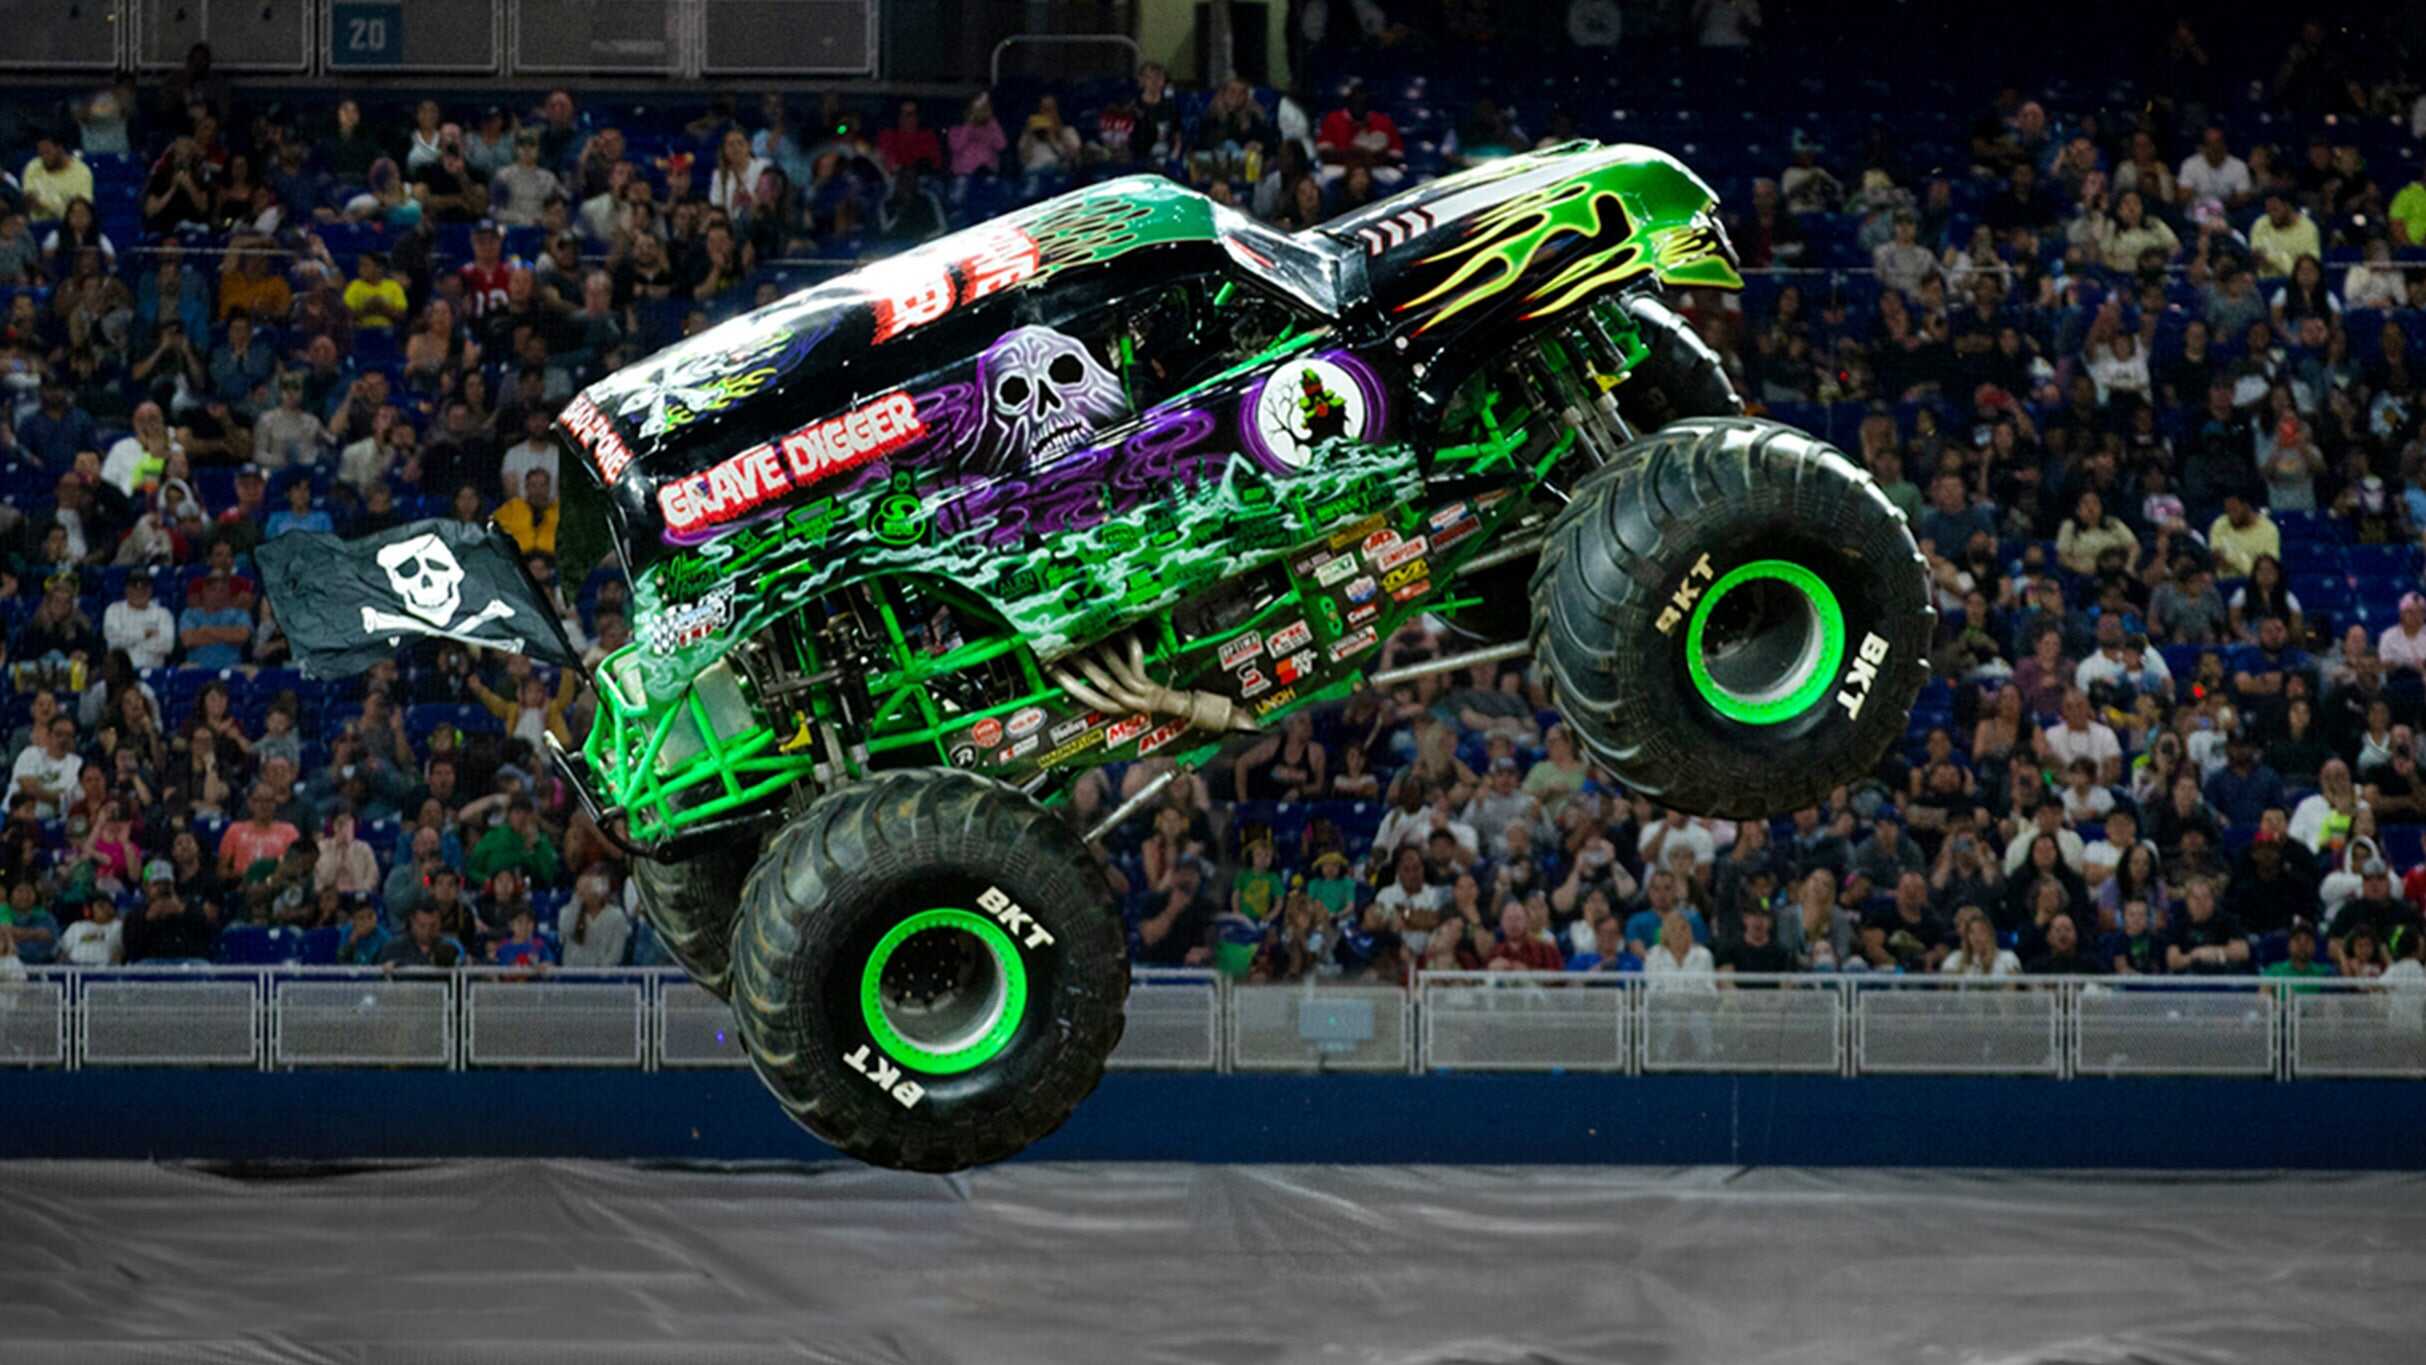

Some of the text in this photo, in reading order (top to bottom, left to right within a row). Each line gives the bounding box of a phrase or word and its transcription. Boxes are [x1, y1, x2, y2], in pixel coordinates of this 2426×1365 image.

[350, 18, 386, 50] 20
[658, 394, 920, 526] GRAVE DIGGER
[1654, 552, 1714, 634] BKT
[1837, 631, 1890, 721] BKT
[976, 885, 1055, 950] BKT
[842, 1044, 926, 1109] BKT
